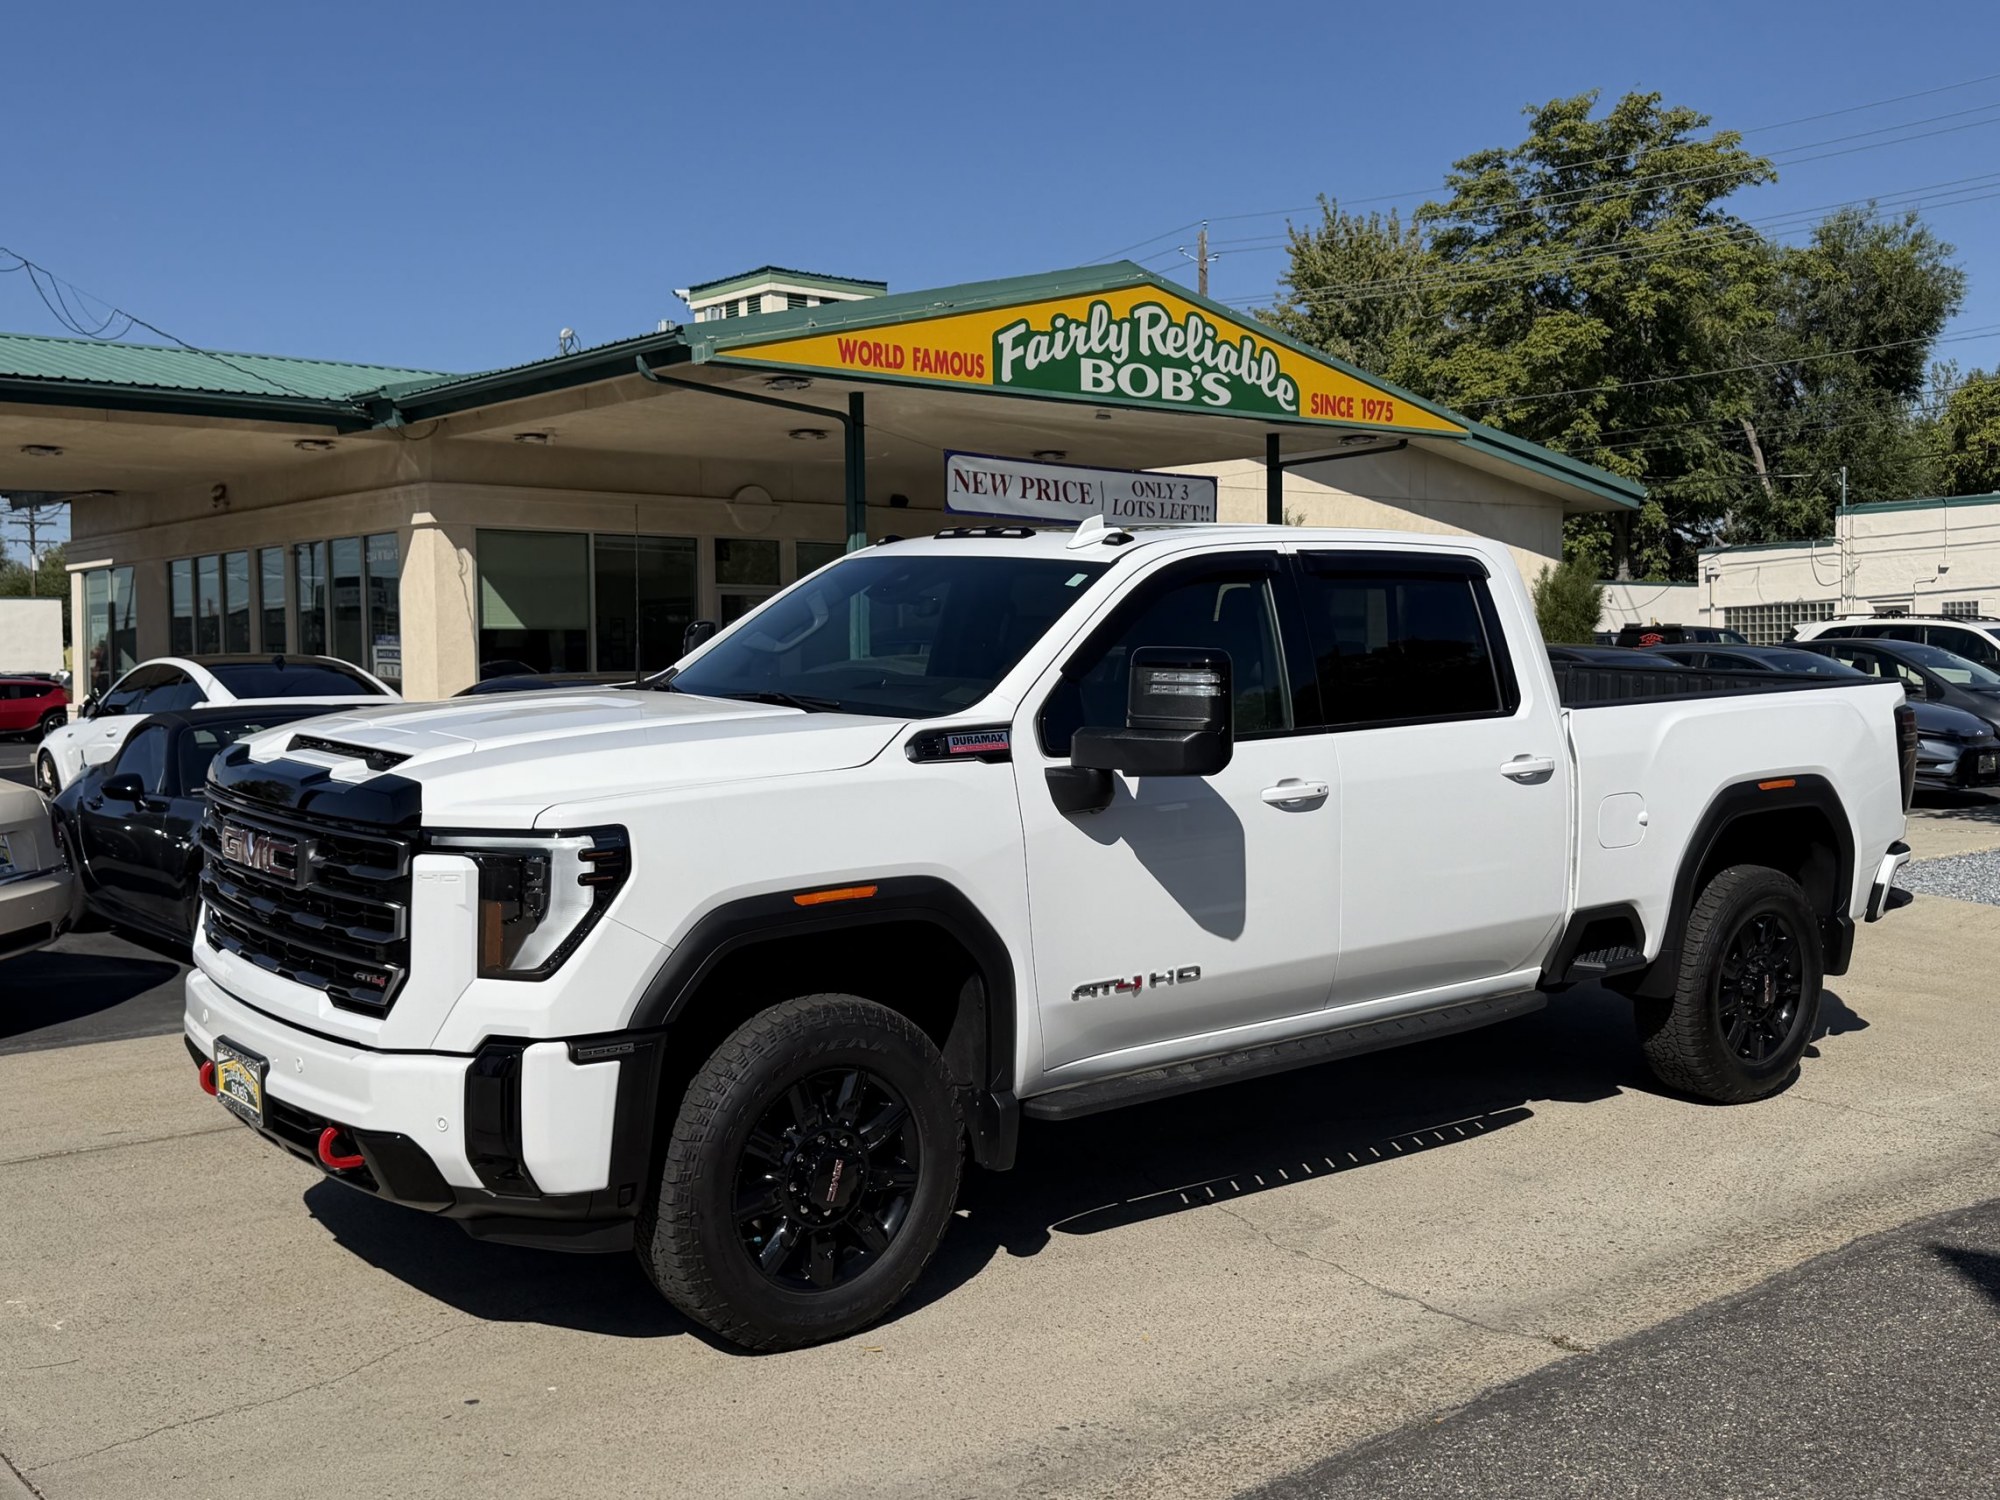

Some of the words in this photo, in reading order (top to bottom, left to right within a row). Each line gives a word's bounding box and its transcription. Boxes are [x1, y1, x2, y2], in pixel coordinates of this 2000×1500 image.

[837, 337, 905, 370] WORLD
[912, 346, 985, 379] FAMOUS
[998, 304, 1130, 383] Fairly
[1133, 305, 1297, 411] Reliable
[1080, 357, 1232, 406] BOB'S
[1310, 392, 1354, 418] SINCE
[1361, 398, 1393, 422] 1975
[953, 468, 1013, 499] NEW
[1019, 475, 1095, 505] PRICE
[1131, 480, 1177, 500] ONLY
[1181, 484, 1189, 500] 3
[1112, 499, 1158, 518] LOTS
[1159, 502, 1210, 522] LEFT!!
[951, 733, 1005, 746] DURAMAX
[221, 825, 297, 880] GMC
[1071, 975, 1143, 1001] AT4
[1149, 965, 1201, 989] HD
